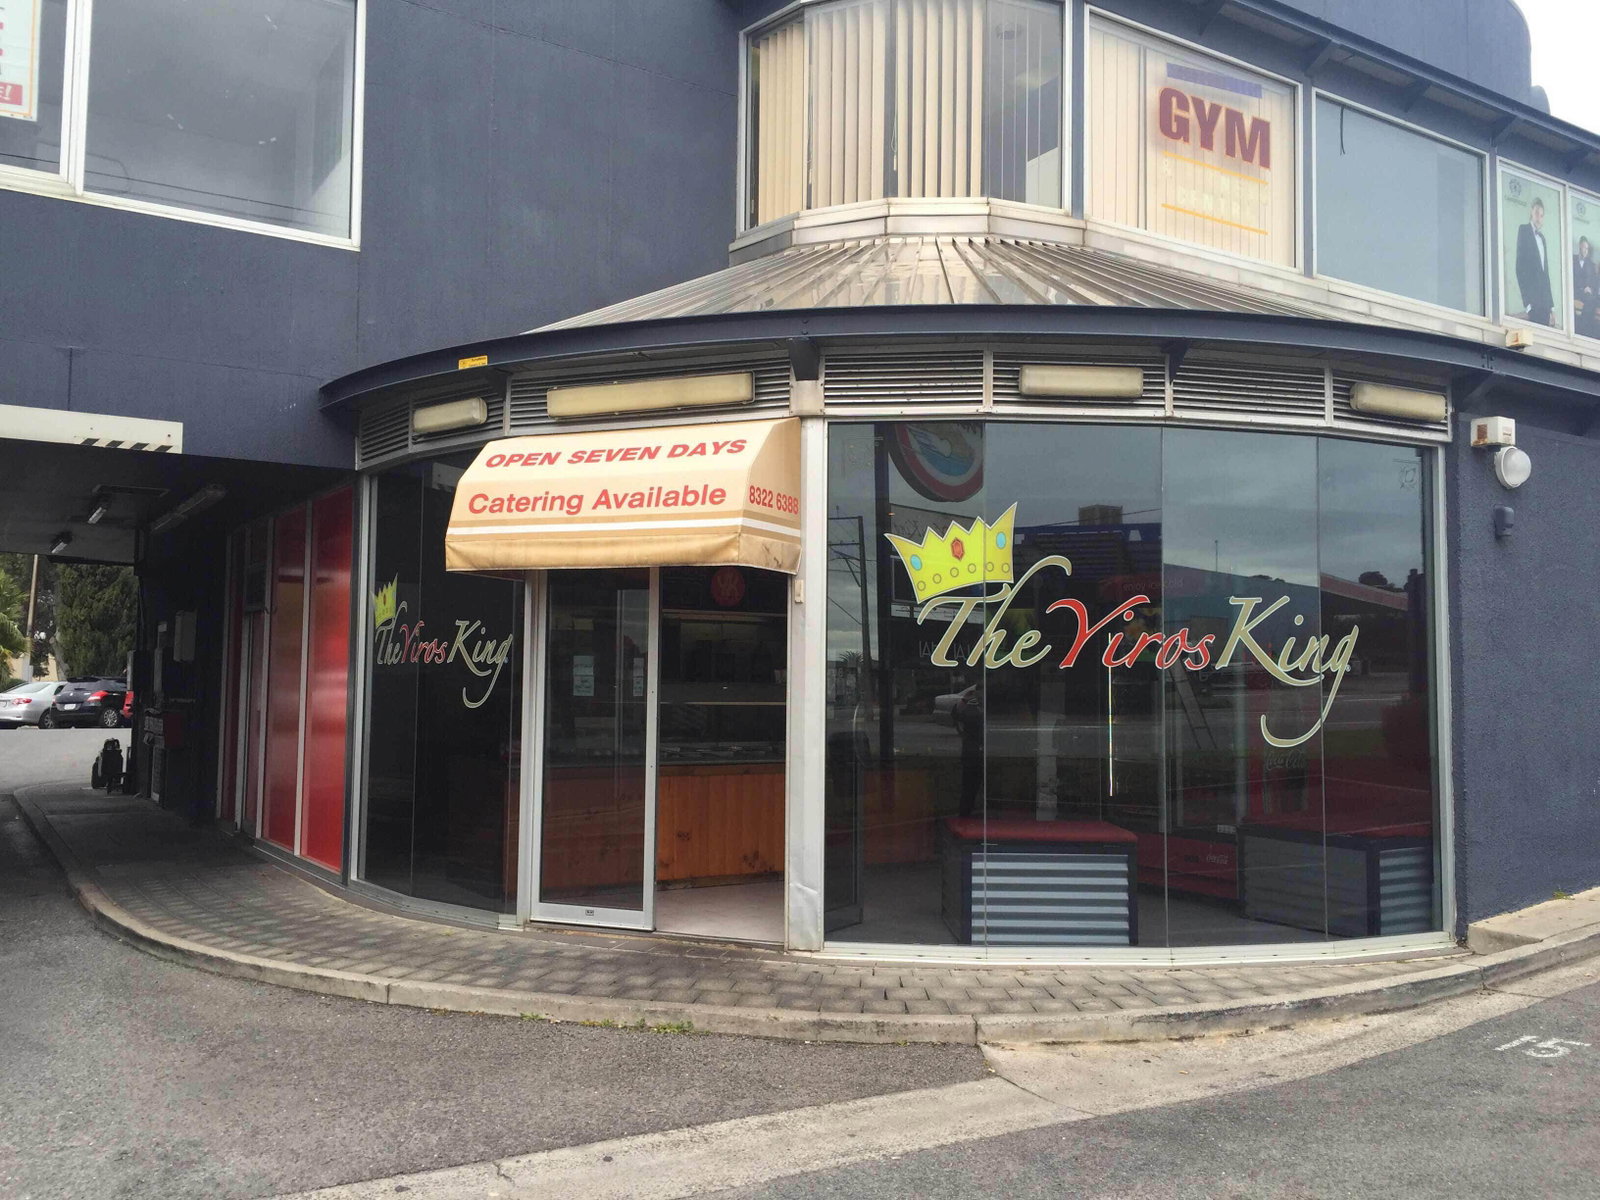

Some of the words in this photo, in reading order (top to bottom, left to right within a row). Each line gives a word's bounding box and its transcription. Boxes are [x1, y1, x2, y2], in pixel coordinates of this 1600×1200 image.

[1159, 87, 1270, 169] GYM
[486, 452, 561, 468] OPEN
[567, 446, 662, 464] SEVEN
[667, 439, 748, 459] DAYS
[468, 490, 584, 516] Catering
[592, 484, 727, 510] Available
[749, 485, 773, 508] 8322
[776, 492, 799, 515] 6388
[375, 600, 408, 665] The
[446, 619, 513, 708] King
[917, 555, 1072, 669] The
[1046, 595, 1215, 671] Yiros
[1215, 595, 1360, 748] King
